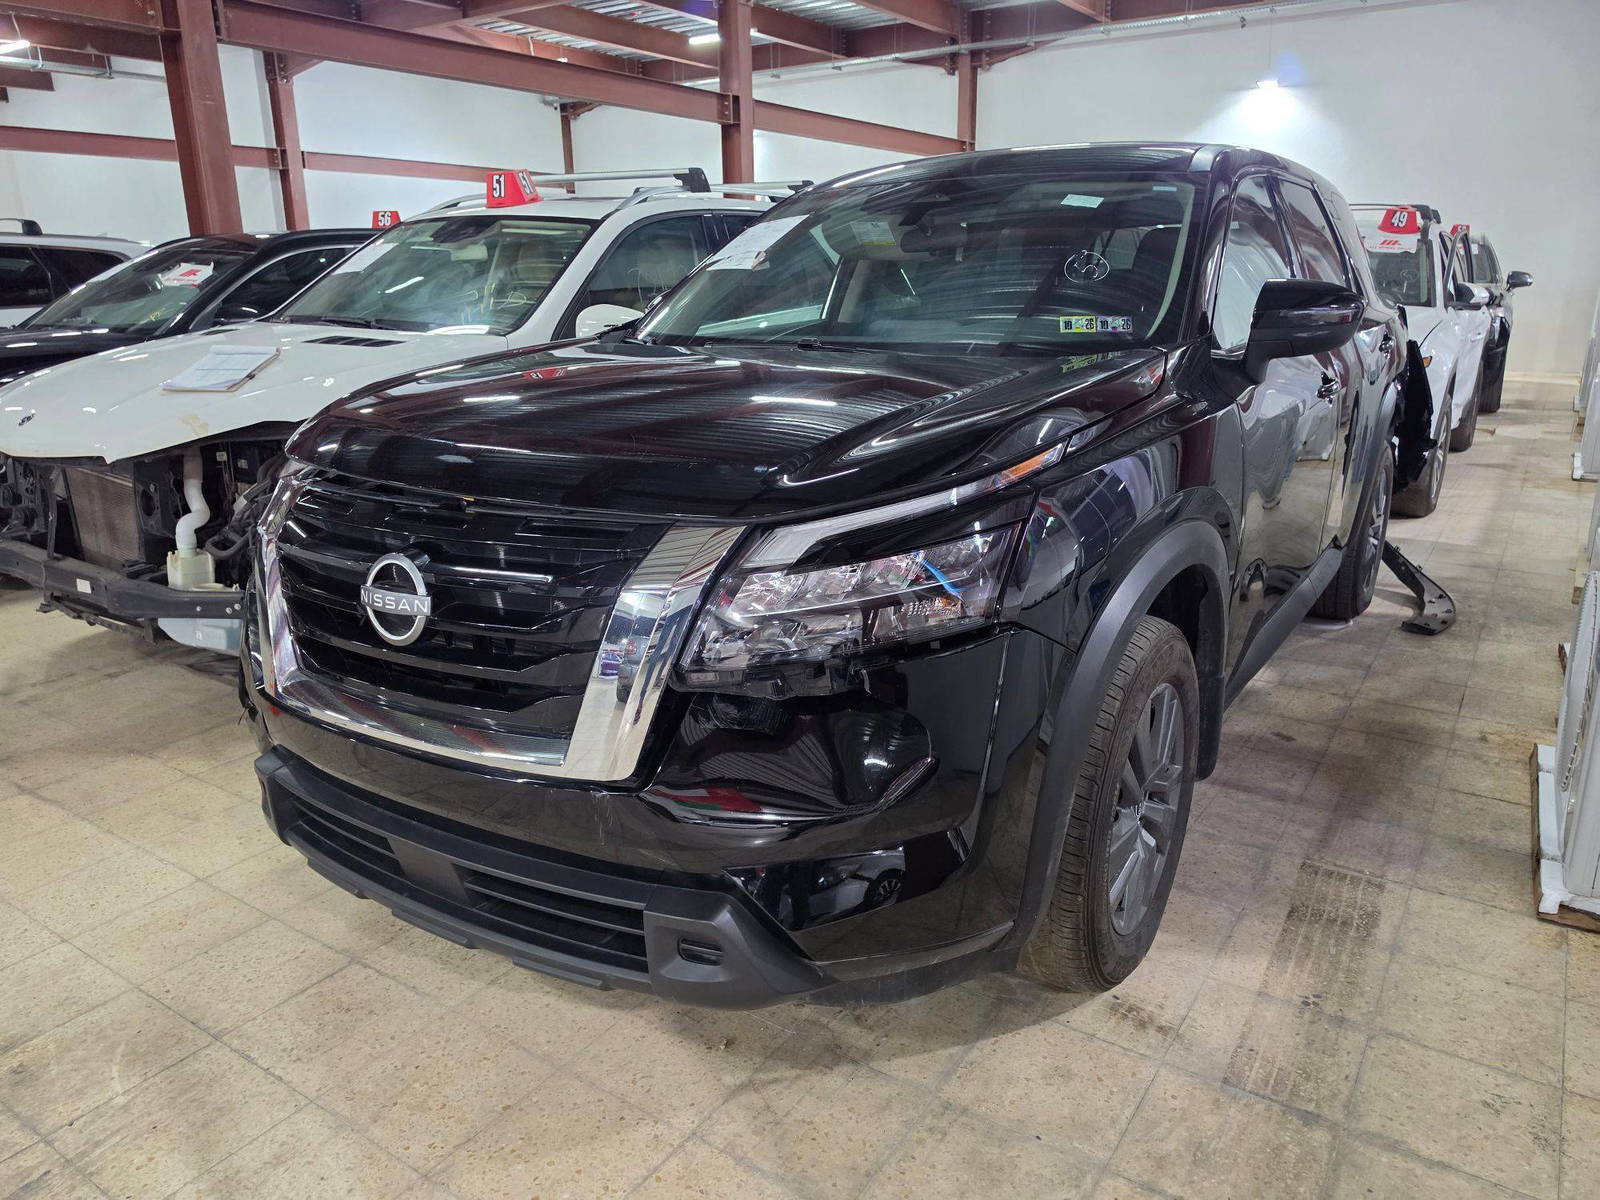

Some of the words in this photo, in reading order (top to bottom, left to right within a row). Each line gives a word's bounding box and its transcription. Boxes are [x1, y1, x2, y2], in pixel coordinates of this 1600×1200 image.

[492, 174, 505, 198] 51
[518, 171, 535, 194] 51
[378, 211, 391, 227] 56
[1391, 210, 1408, 228] 49
[1085, 318, 1095, 330] 26
[1121, 318, 1131, 330] 26
[361, 588, 428, 613] NISSAN
